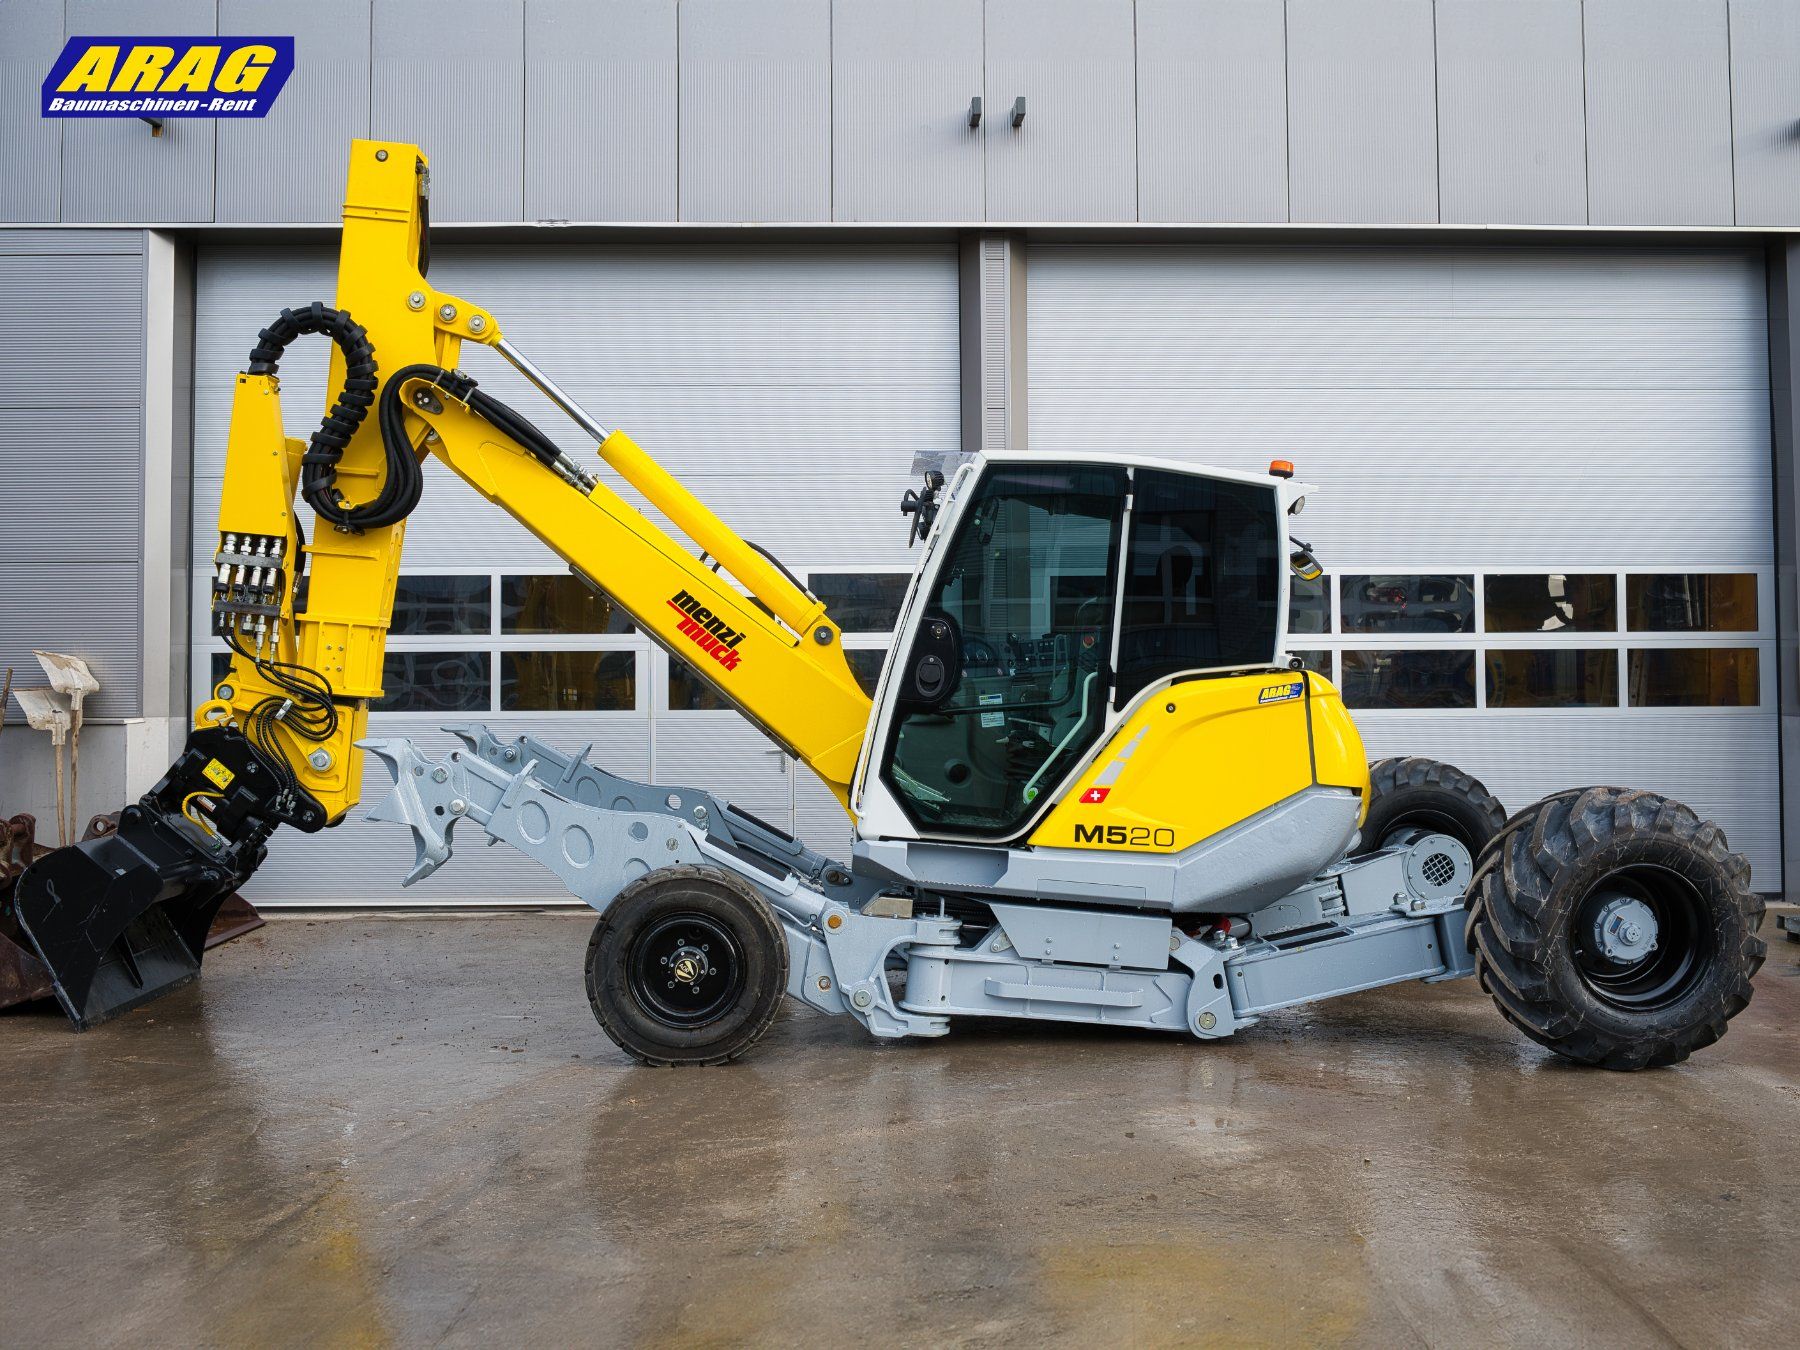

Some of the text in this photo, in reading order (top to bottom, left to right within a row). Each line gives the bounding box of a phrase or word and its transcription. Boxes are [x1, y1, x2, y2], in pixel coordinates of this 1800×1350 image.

[669, 605, 743, 672] muck
[670, 589, 747, 650] menzi
[1260, 684, 1292, 700] ARAG
[1074, 824, 1175, 847] M520
